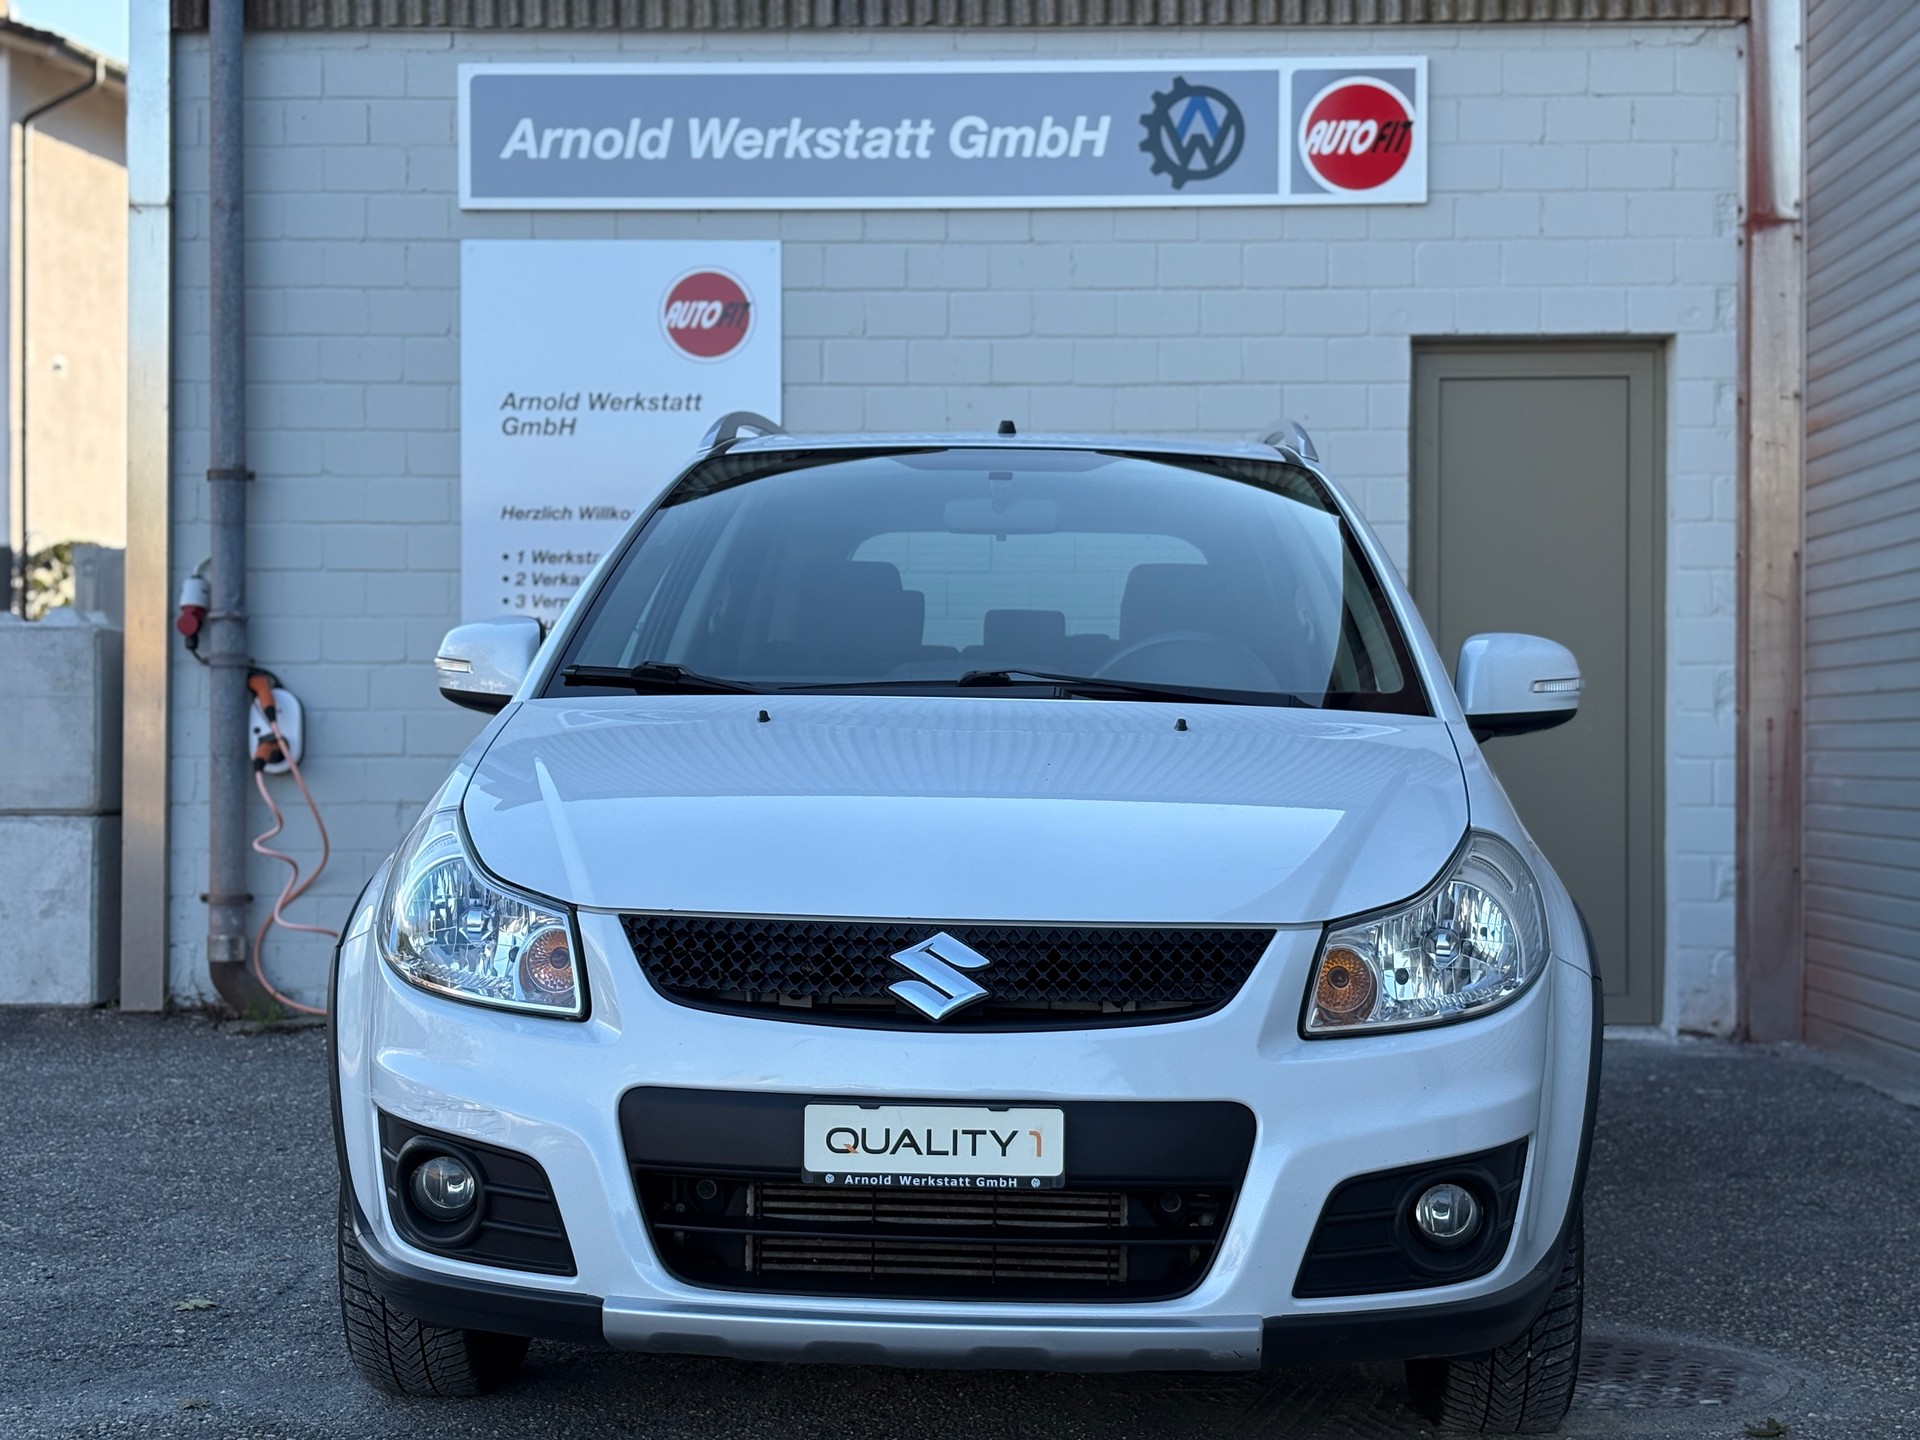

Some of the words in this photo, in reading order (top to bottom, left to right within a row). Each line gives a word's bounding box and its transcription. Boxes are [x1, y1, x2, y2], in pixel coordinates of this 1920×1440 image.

[500, 117, 674, 160] Arnold
[688, 117, 935, 160] Werkstatt
[948, 115, 1111, 160] GmbH
[500, 391, 581, 411] Arnold
[588, 391, 703, 412] Werkstatt
[502, 416, 577, 436] GmbH
[500, 506, 572, 521] Herzlich
[578, 506, 633, 521] Willko
[517, 551, 525, 564] 1
[515, 572, 526, 587] 2
[531, 572, 584, 587] Verka
[515, 594, 526, 609] 3
[845, 1174, 892, 1186] Arnold
[899, 1175, 971, 1187] Werkstatt
[976, 1176, 1018, 1188] GmbH
